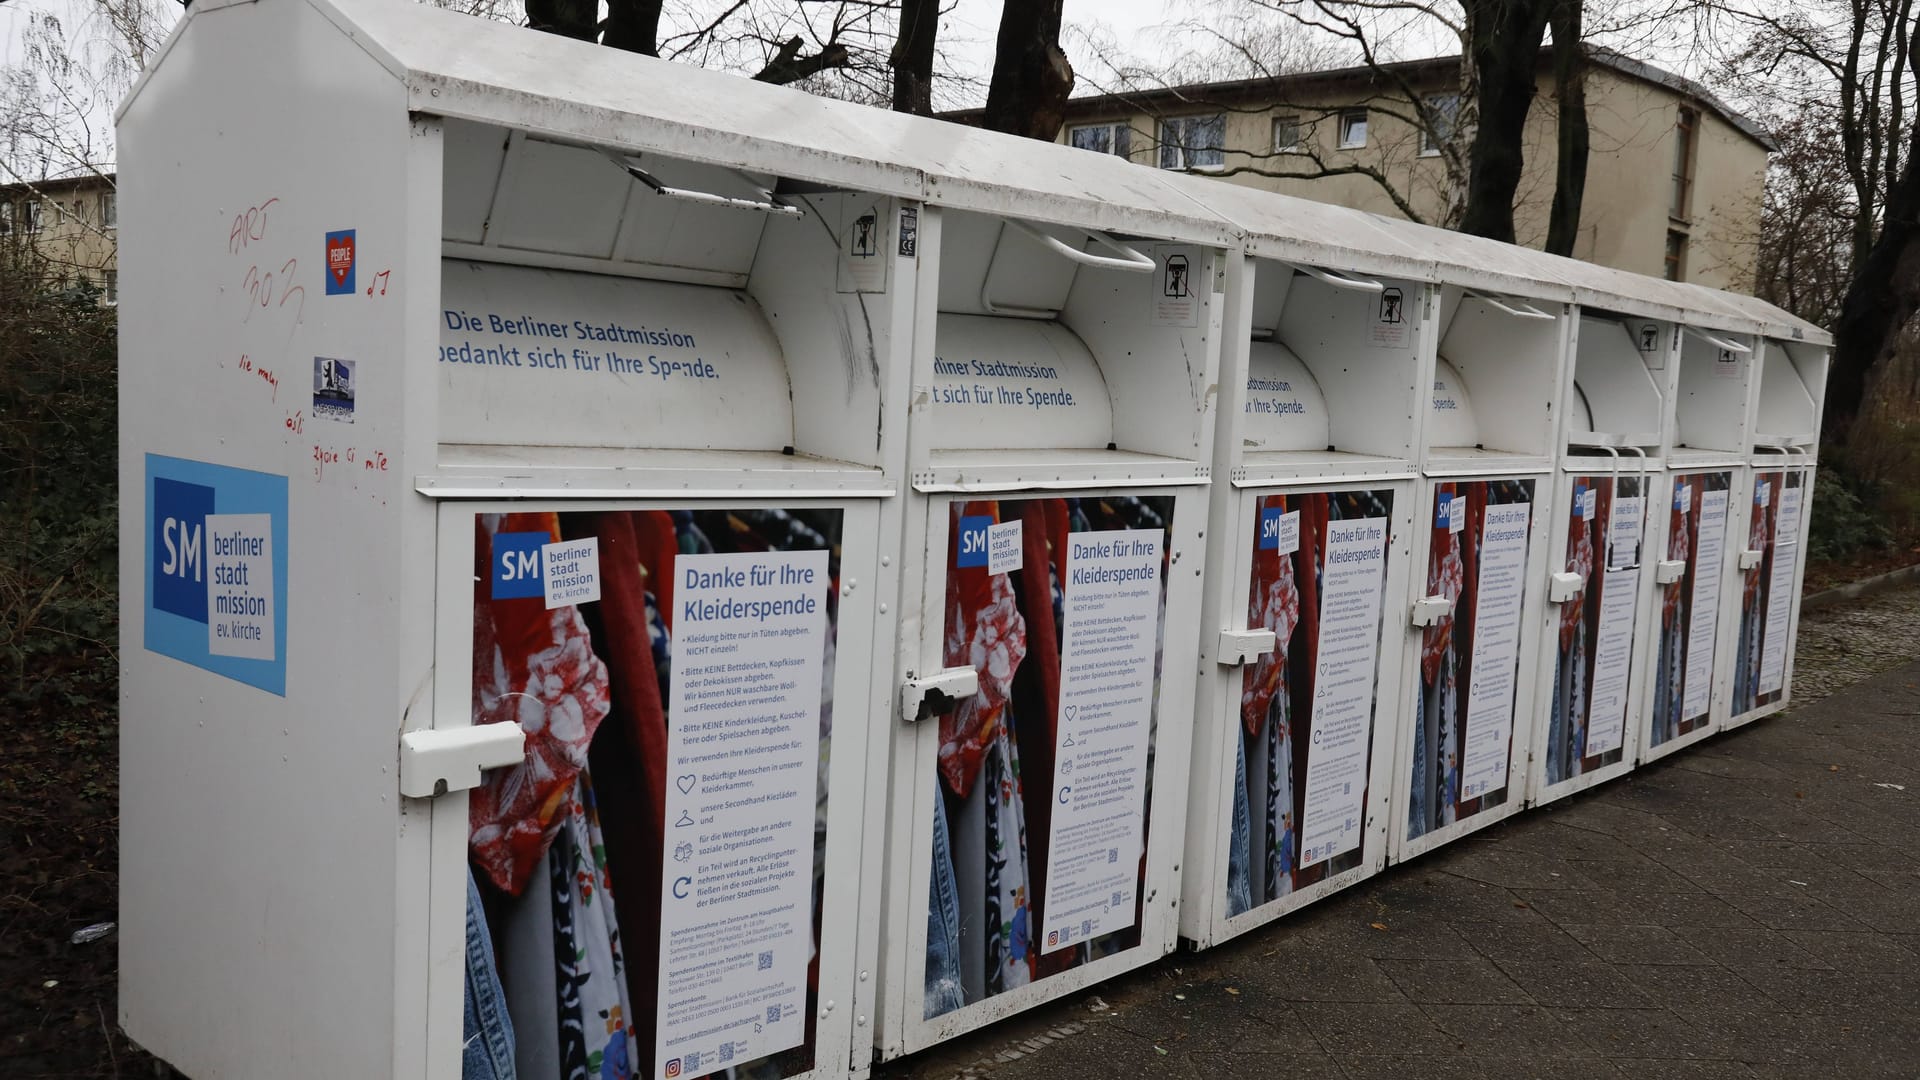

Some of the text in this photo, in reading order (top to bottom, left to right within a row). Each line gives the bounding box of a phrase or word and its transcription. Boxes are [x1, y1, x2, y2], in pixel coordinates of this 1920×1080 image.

[229, 197, 279, 254] ART
[331, 247, 351, 262] PEOPLE
[444, 311, 696, 348] Die Berliner Stadtmission
[527, 346, 567, 369] sich
[573, 349, 600, 372] für
[606, 352, 643, 374] Ihre
[649, 356, 720, 381] Spende.
[971, 359, 1058, 379] Stadtmission
[943, 384, 970, 404] sich
[974, 384, 993, 404] für
[997, 386, 1024, 405] Ihre
[1026, 387, 1076, 410] Spende.
[1253, 397, 1271, 413] Ihre
[1272, 398, 1306, 417] Spende.
[1438, 502, 1450, 519] SM
[1487, 511, 1526, 525] Danke für Ihre
[992, 527, 1019, 540] berliner
[1263, 519, 1278, 538] SM
[1331, 526, 1381, 544] Danke für Ihre
[1486, 528, 1525, 543] Kleiderspende
[163, 517, 201, 583] SM
[214, 531, 264, 557] berliner
[963, 529, 986, 553] SM
[992, 538, 1010, 551] stadt
[1074, 540, 1154, 560] Danke für Ihre
[550, 547, 592, 563] berliner
[992, 547, 1019, 560] mission
[1329, 546, 1380, 564] Kleiderspende
[215, 561, 249, 586] stadt
[502, 550, 538, 580] SM
[551, 562, 580, 576] stadt
[1073, 564, 1154, 585] Kleiderspende
[552, 574, 593, 589] mission
[686, 564, 814, 589] Danke für Ihre
[216, 589, 266, 617] mission
[553, 586, 590, 600] ev. kirche
[685, 594, 815, 621] Kleiderspende
[217, 621, 262, 641] ev. kirche
[687, 627, 810, 644] Kleidung bitte nur in Tüten abgeben.
[686, 644, 738, 656] NICHT einzeln!
[685, 658, 805, 677] Bitte KEINE Bettdecken, Kopfkissen
[684, 672, 775, 689] oder Dekokissen abgeben.
[684, 692, 697, 701] Wir
[698, 690, 725, 699] können
[726, 687, 742, 696] NUR
[743, 684, 779, 694] waschbare
[684, 704, 699, 713] und
[700, 699, 747, 711] Fleecedecken
[683, 710, 807, 733] Bitte KEINE Kinderkleidung, Kuschel-
[682, 725, 790, 745] tiere oder Spielsachen abgeben.
[677, 756, 690, 765] Wir
[691, 752, 729, 763] verwenden
[729, 749, 744, 758] Ihre
[744, 743, 790, 756] Kleiderspende
[702, 761, 803, 783] Bedürftige Menschen in unserer
[701, 781, 754, 794] Kleiderkammer,
[700, 791, 797, 813] unsere Secondhand Kiezläden
[700, 815, 714, 825] und
[699, 821, 792, 844] für die Weitergabe an andere
[699, 836, 774, 856] soziale Organisationen.
[697, 861, 790, 885] nehmen verkauft. Alle Erlöse
[698, 865, 707, 874] Ein
[710, 862, 723, 871] Teil
[723, 859, 739, 869] wird
[739, 858, 749, 866] an
[697, 870, 795, 897] fließen in die sozialen Projekte
[696, 885, 780, 908] der Berliner Stadtmission.
